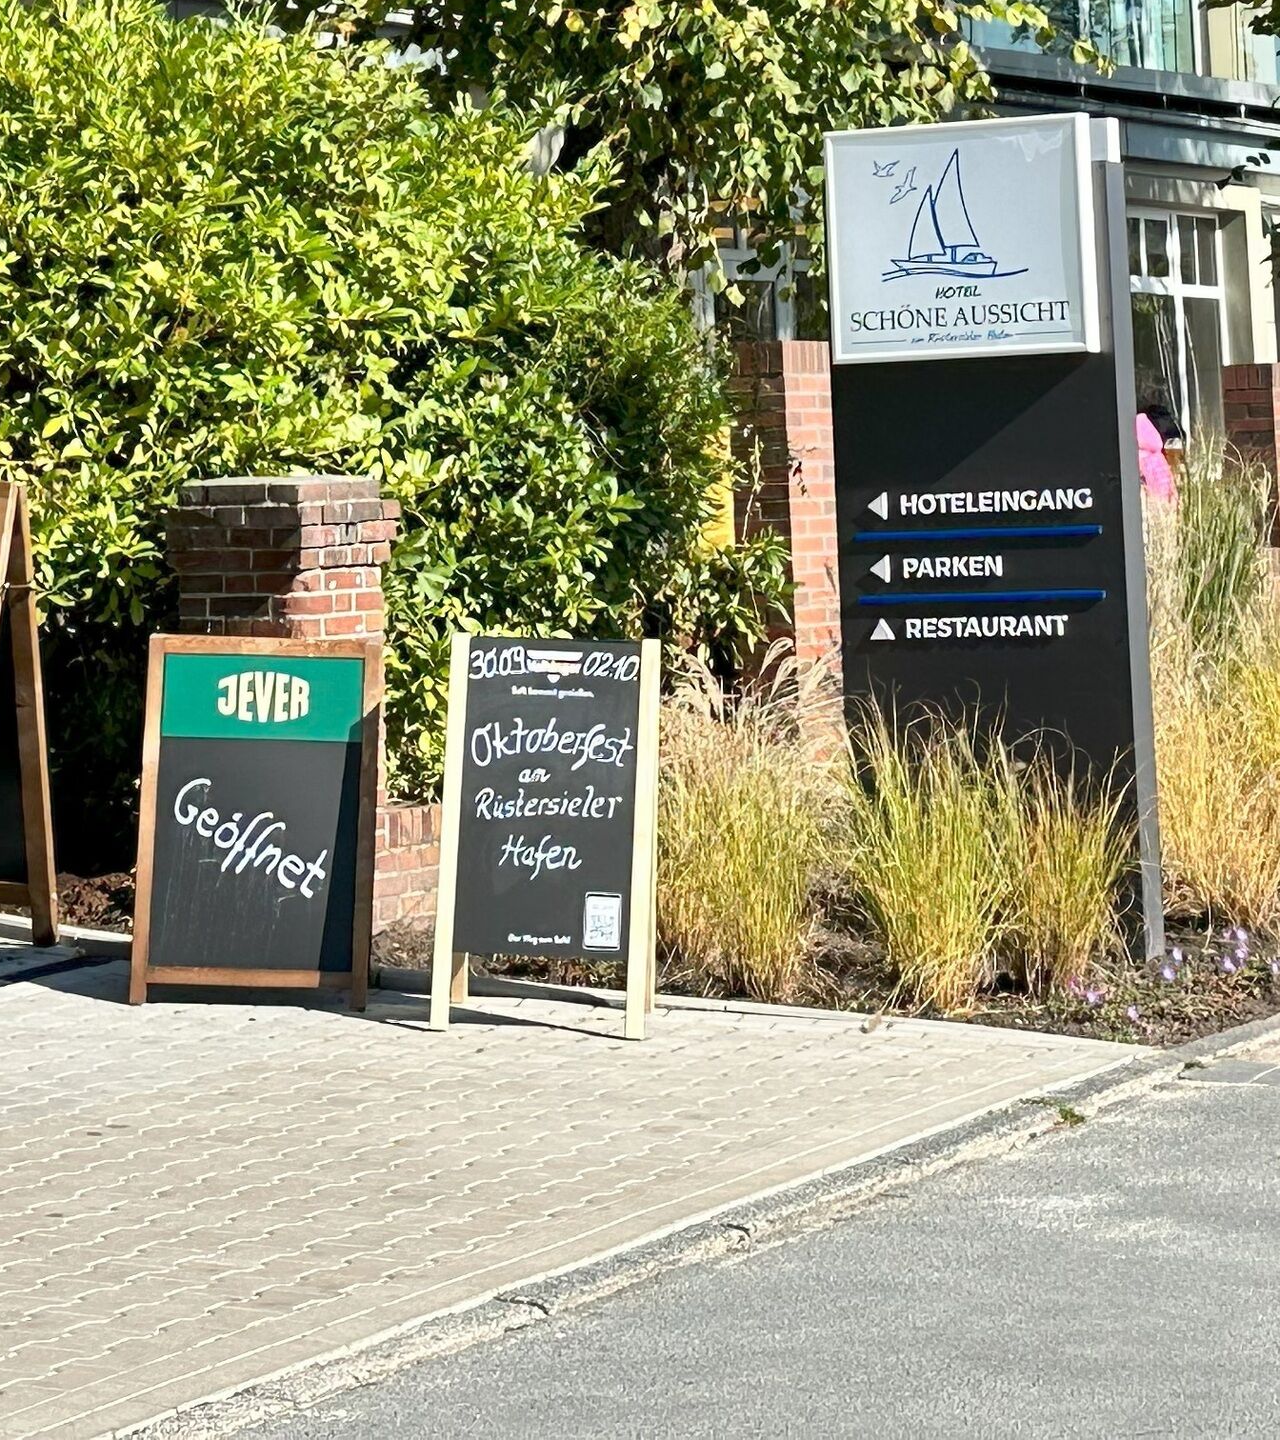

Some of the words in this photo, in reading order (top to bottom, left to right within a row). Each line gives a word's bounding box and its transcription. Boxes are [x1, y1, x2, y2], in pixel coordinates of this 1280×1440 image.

[934, 285, 983, 300] HOTEL
[849, 303, 949, 333] SCHÖNE
[952, 299, 1071, 328] AUSSICHT
[899, 487, 1094, 516] HOTELEINGANG
[902, 555, 1004, 580] PARKEN
[905, 614, 1069, 639] RESTAURANT
[216, 670, 311, 724] JEVER
[470, 716, 635, 772] Oktoberfest
[474, 784, 624, 821] Rüstersieler
[173, 777, 329, 900] Geöffnet
[497, 833, 583, 881] Hafen
